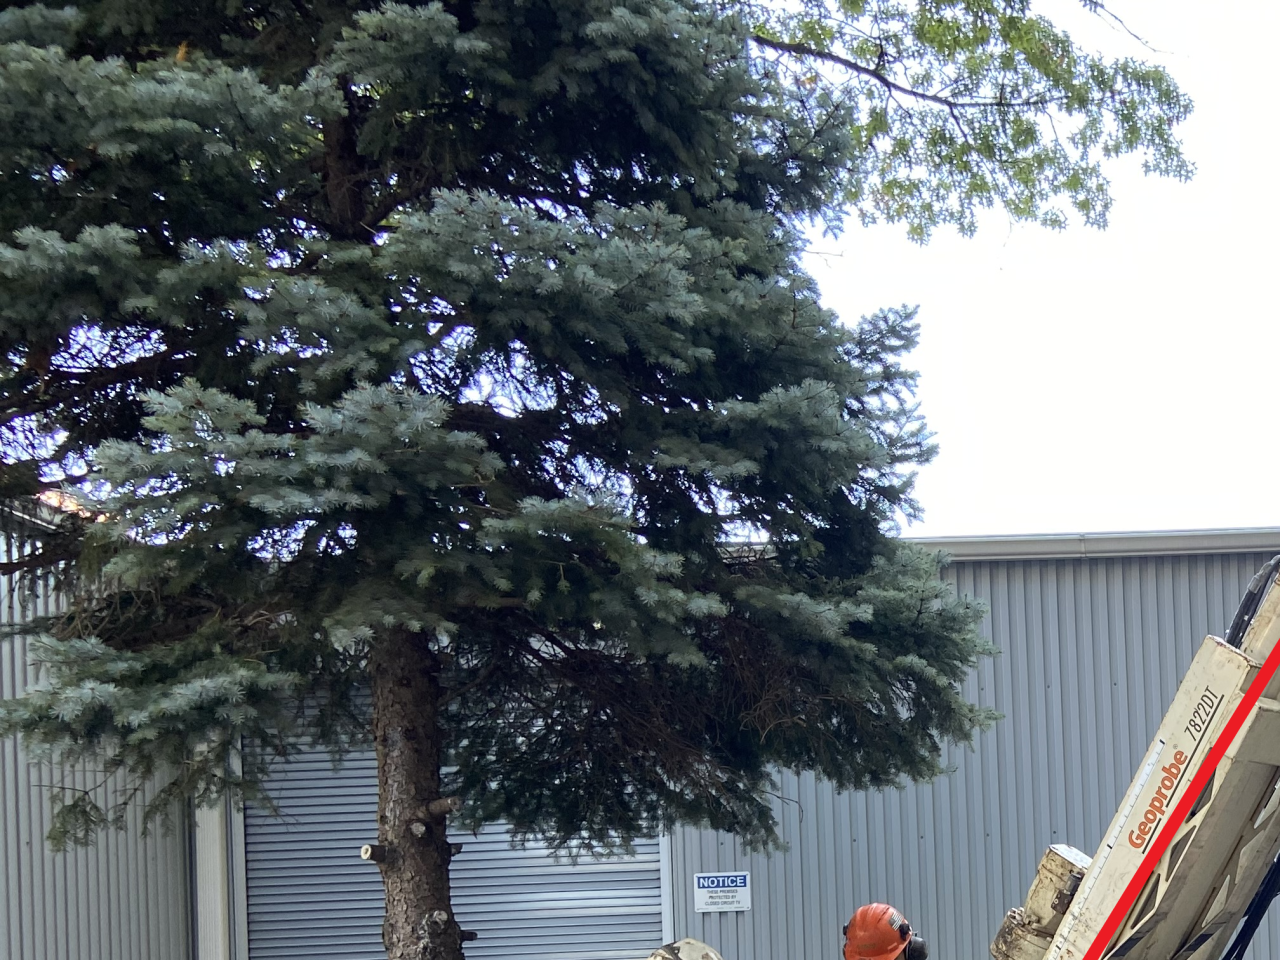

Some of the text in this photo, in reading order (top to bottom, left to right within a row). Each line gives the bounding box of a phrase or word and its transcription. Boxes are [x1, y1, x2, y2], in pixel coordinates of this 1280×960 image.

[1128, 685, 1219, 850] Geoprobe 7822DT
[700, 877, 744, 887] NOTICE
